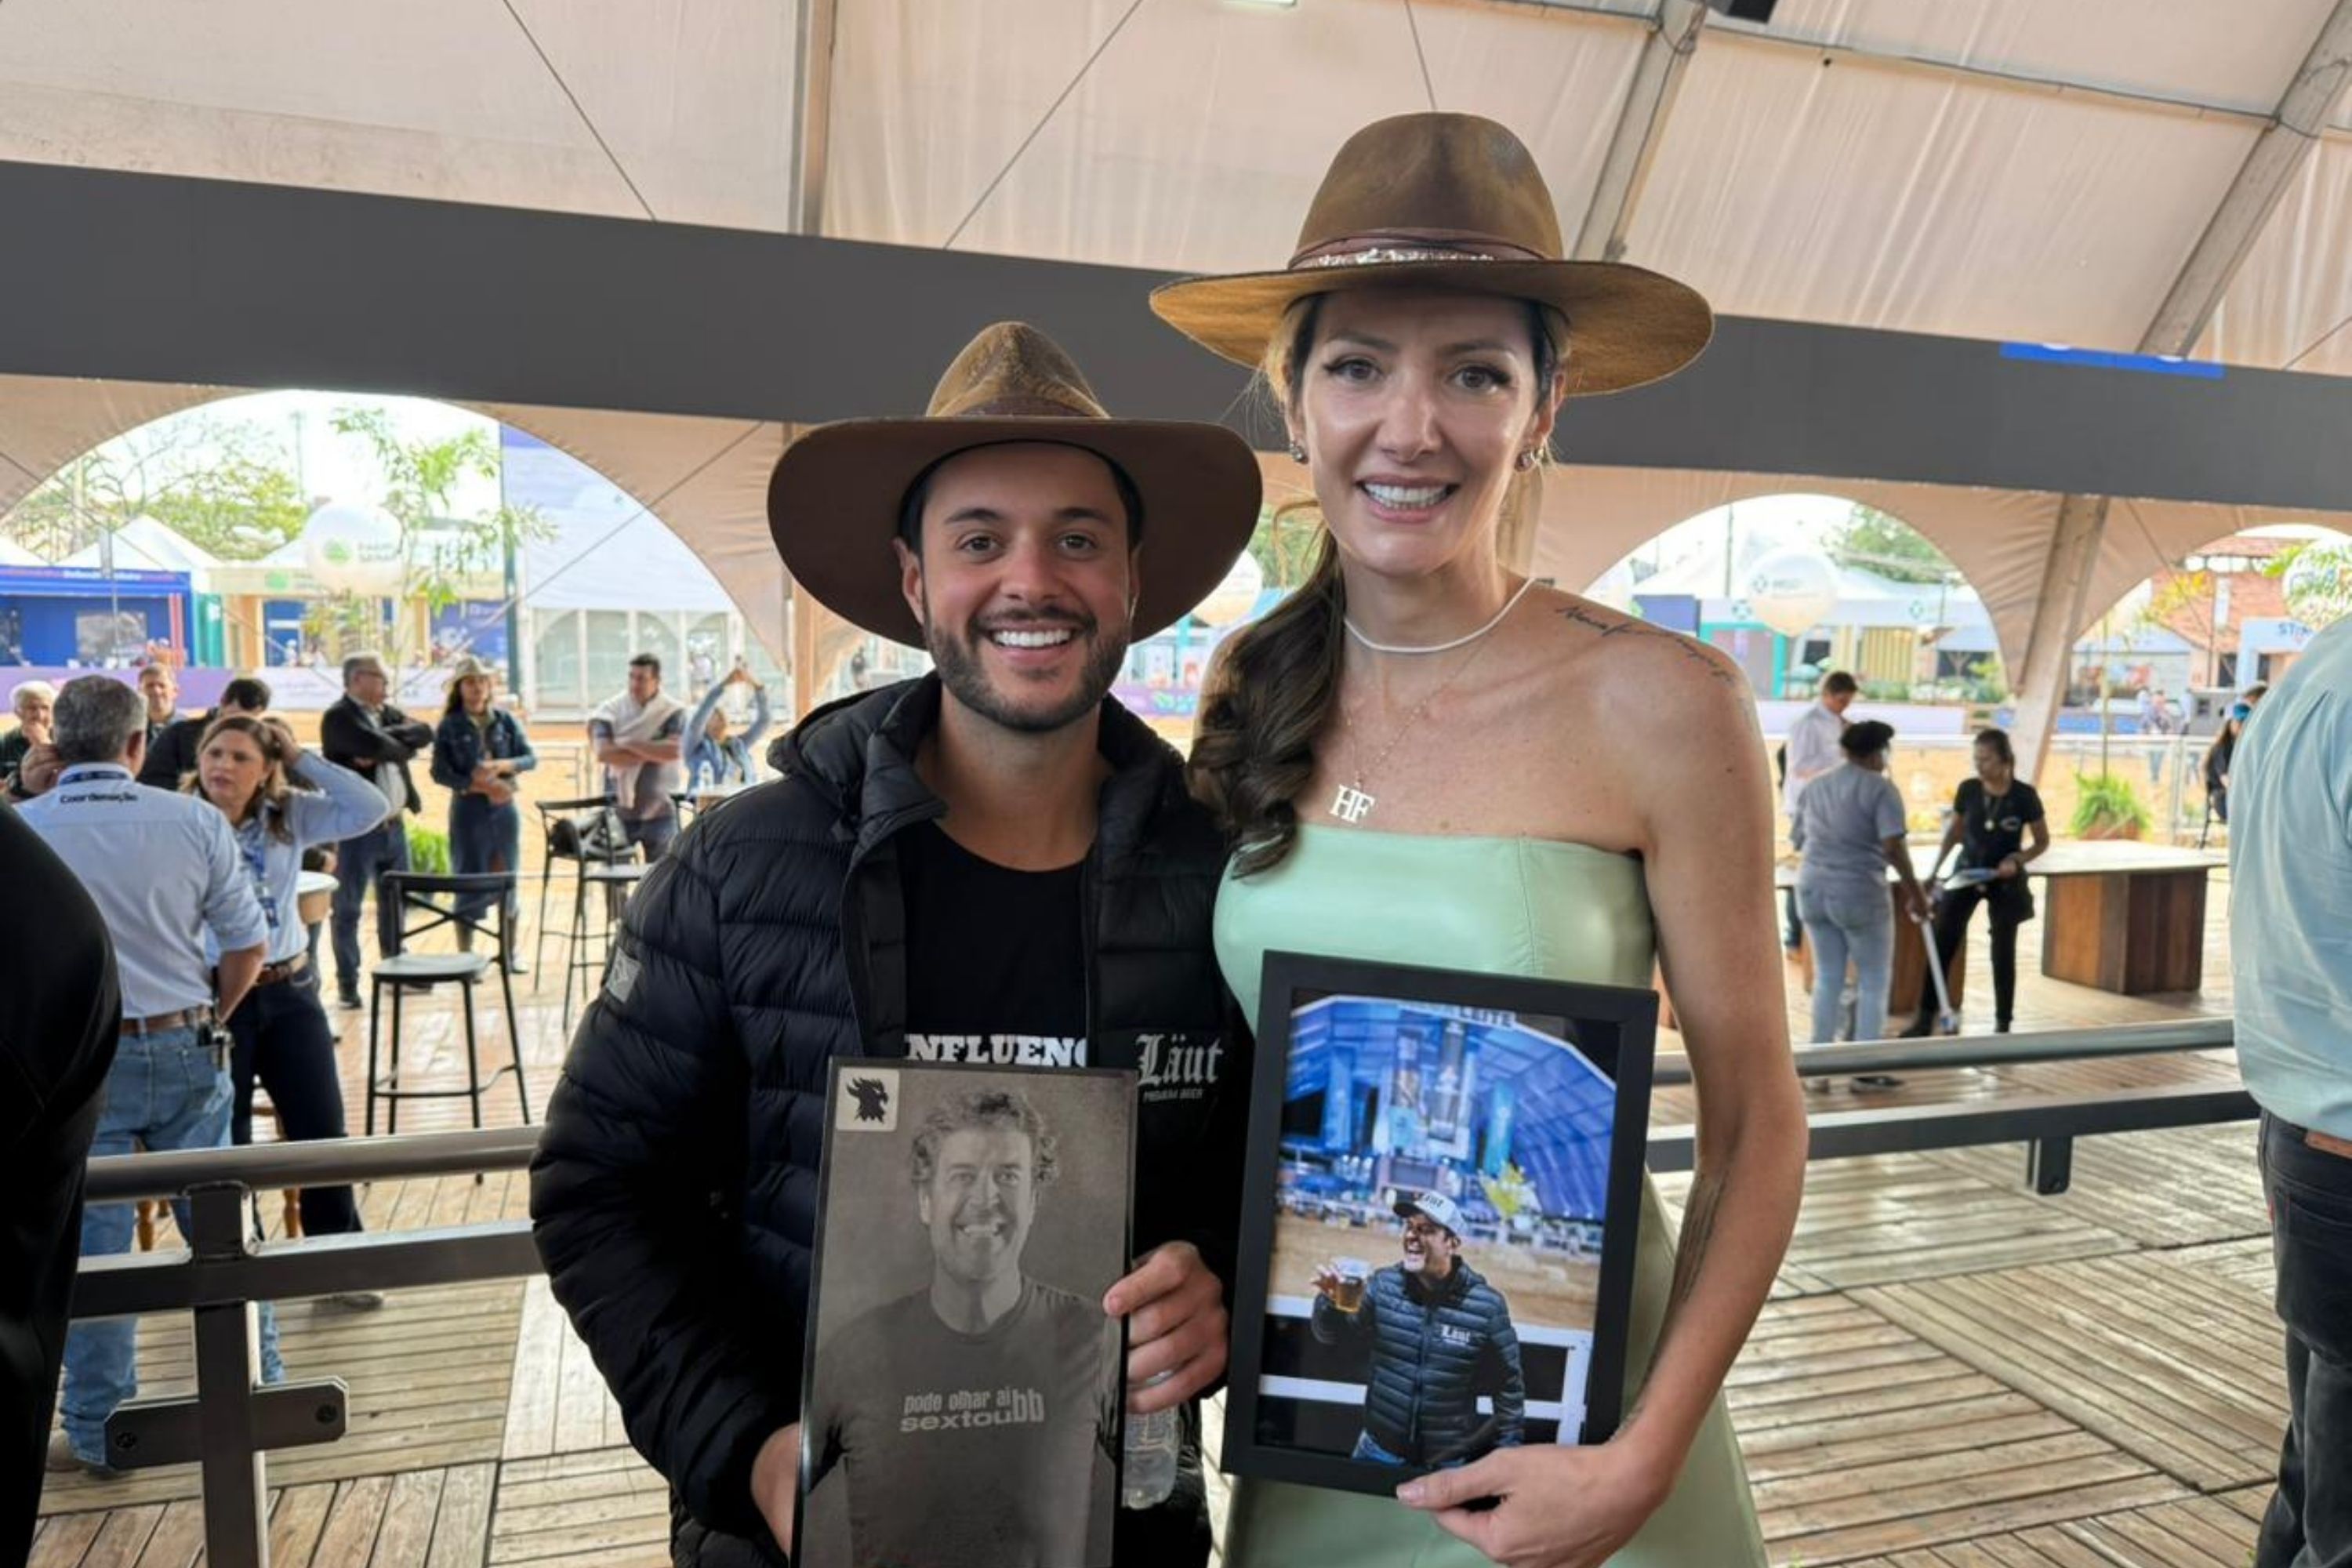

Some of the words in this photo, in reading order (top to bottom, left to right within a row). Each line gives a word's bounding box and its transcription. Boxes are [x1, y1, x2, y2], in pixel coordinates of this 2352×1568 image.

[1329, 784, 1375, 823] HF
[903, 1033, 1087, 1067] NFLUEN
[1135, 1033, 1223, 1087] Läut
[904, 1393, 942, 1414] pode
